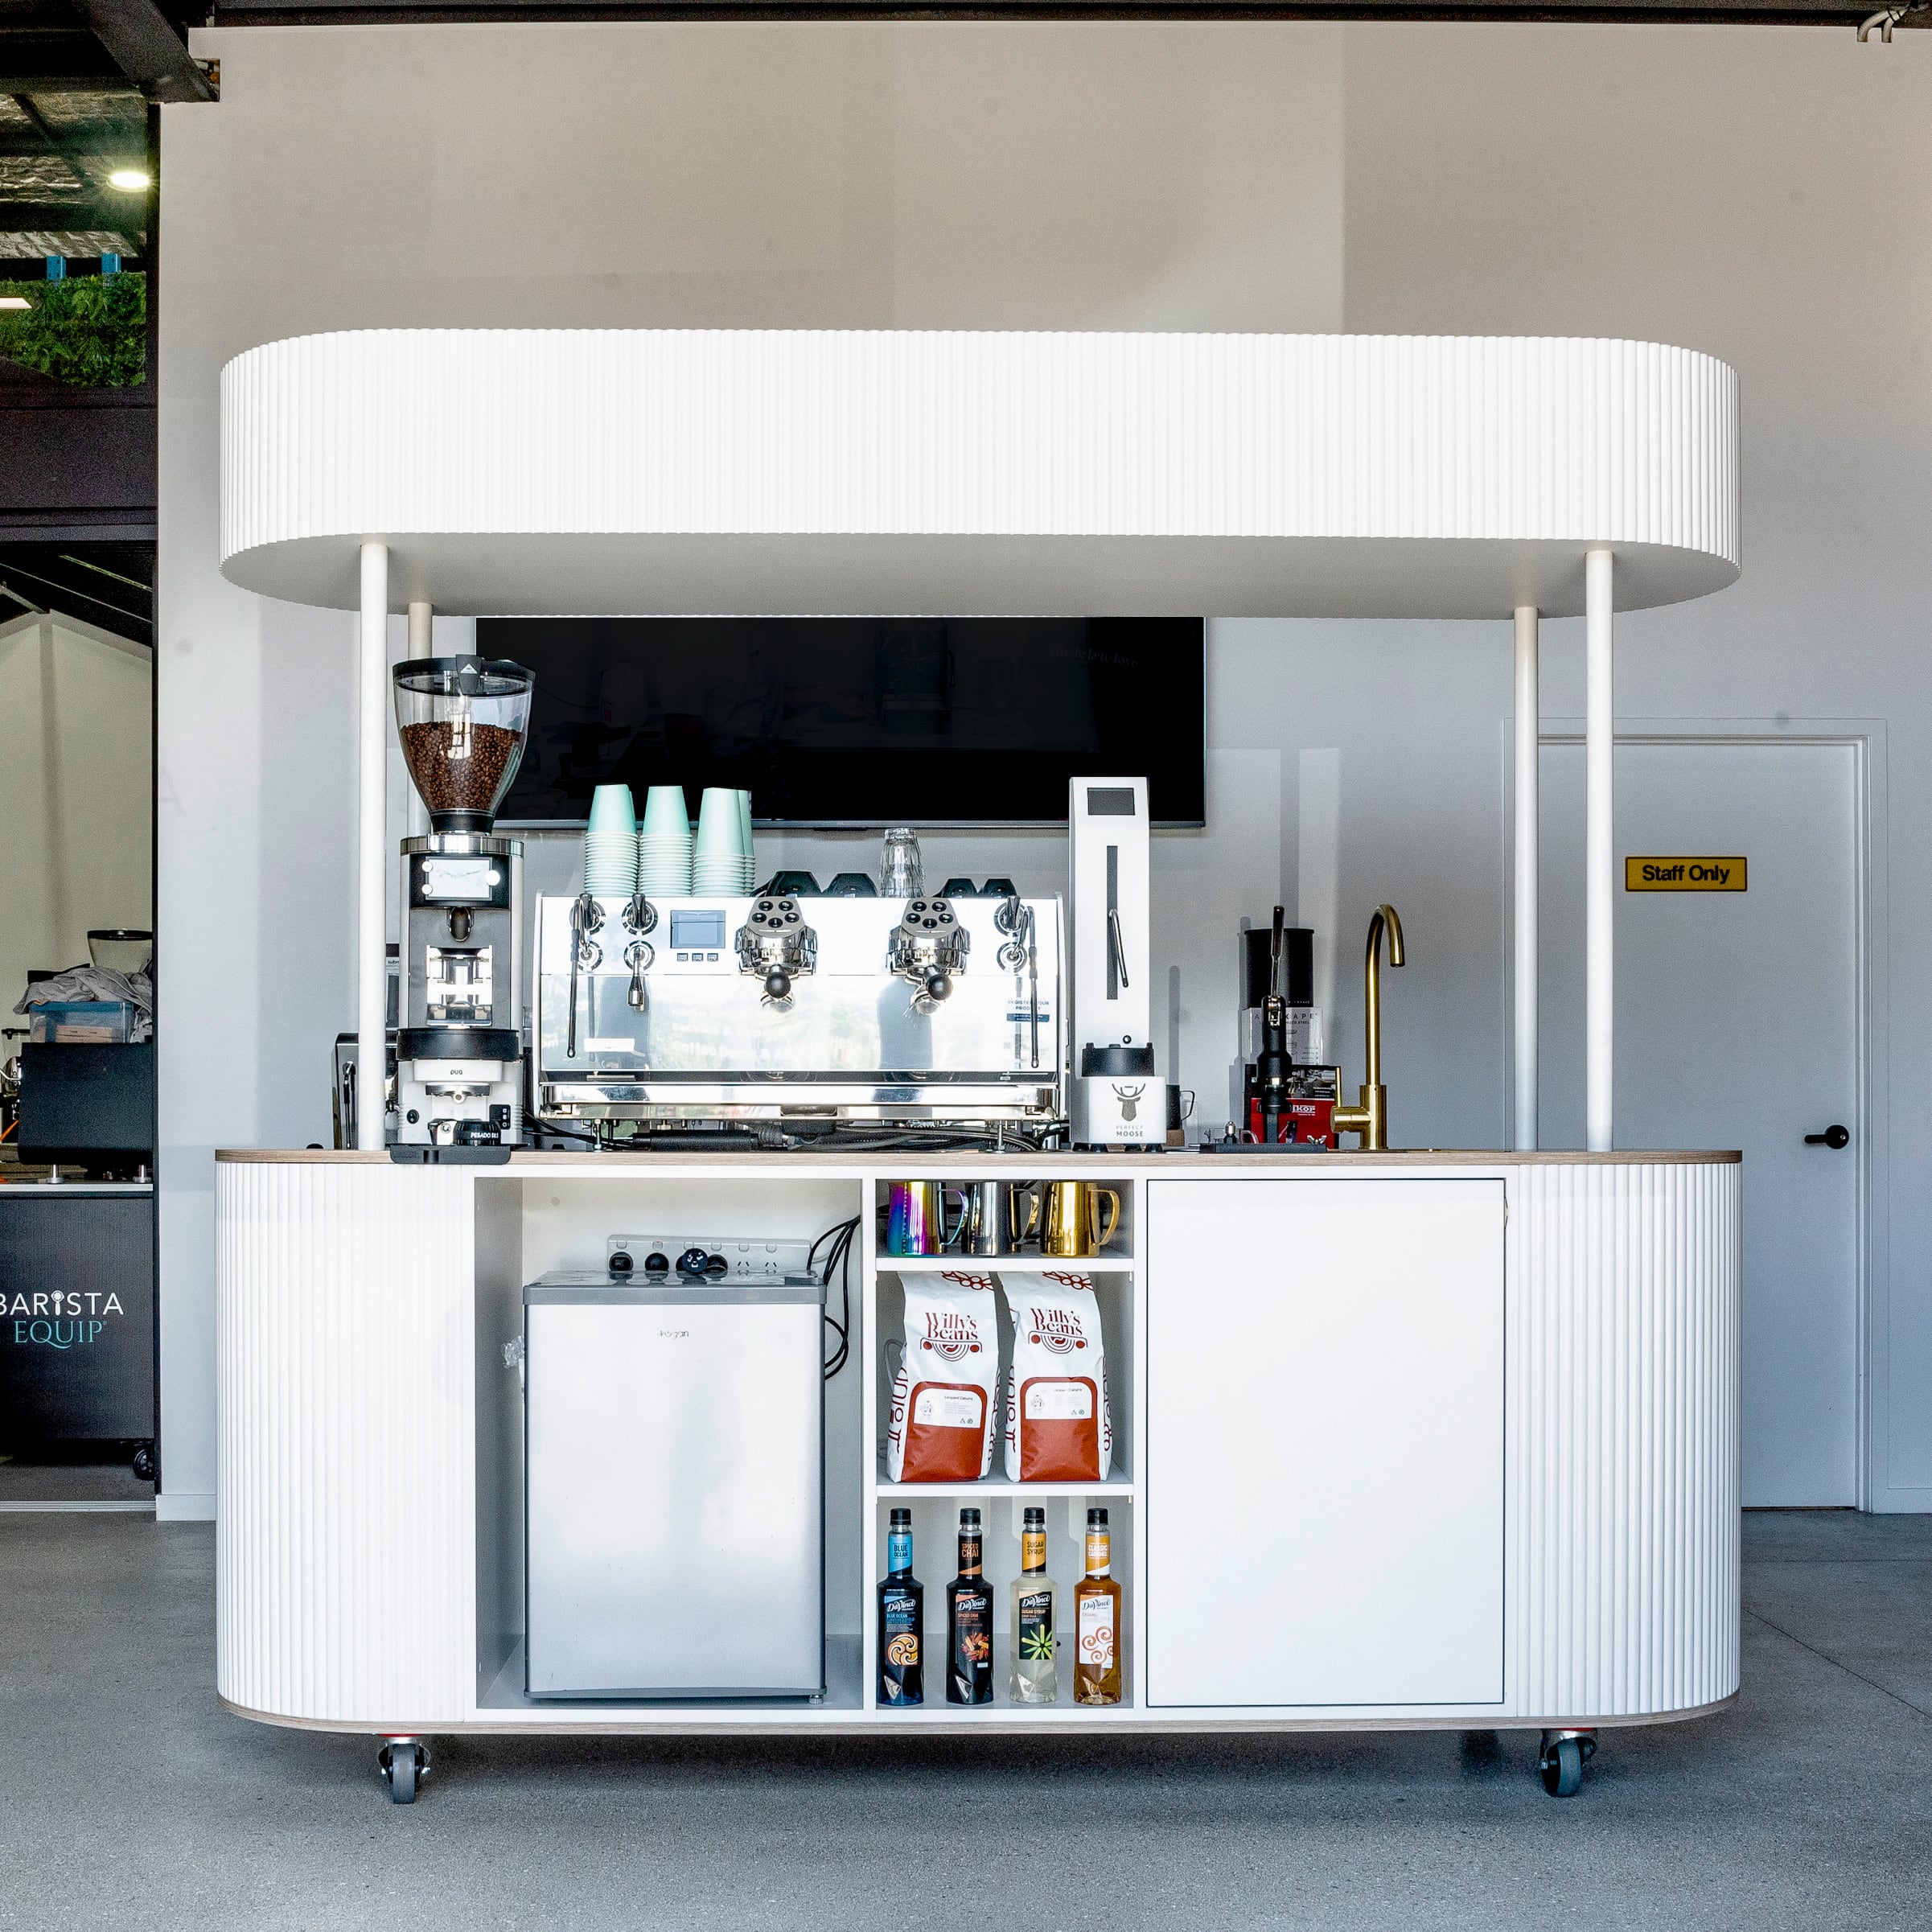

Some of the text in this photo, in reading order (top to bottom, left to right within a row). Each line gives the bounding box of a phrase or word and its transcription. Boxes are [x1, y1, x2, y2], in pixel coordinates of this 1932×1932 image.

[1642, 865, 1730, 885] Staff Only
[926, 1313, 976, 1330] Willy's
[1030, 1307, 1080, 1326] Willy's
[14, 1320, 102, 1349] EQUIP
[927, 1324, 978, 1340] Beans
[1034, 1317, 1083, 1336] Beans
[961, 1549, 979, 1557] CHAI
[887, 1599, 916, 1612] DaVinci
[958, 1597, 987, 1611] DaVinci
[1021, 1594, 1050, 1607] DaVinci
[1083, 1599, 1111, 1610] DaVinci
